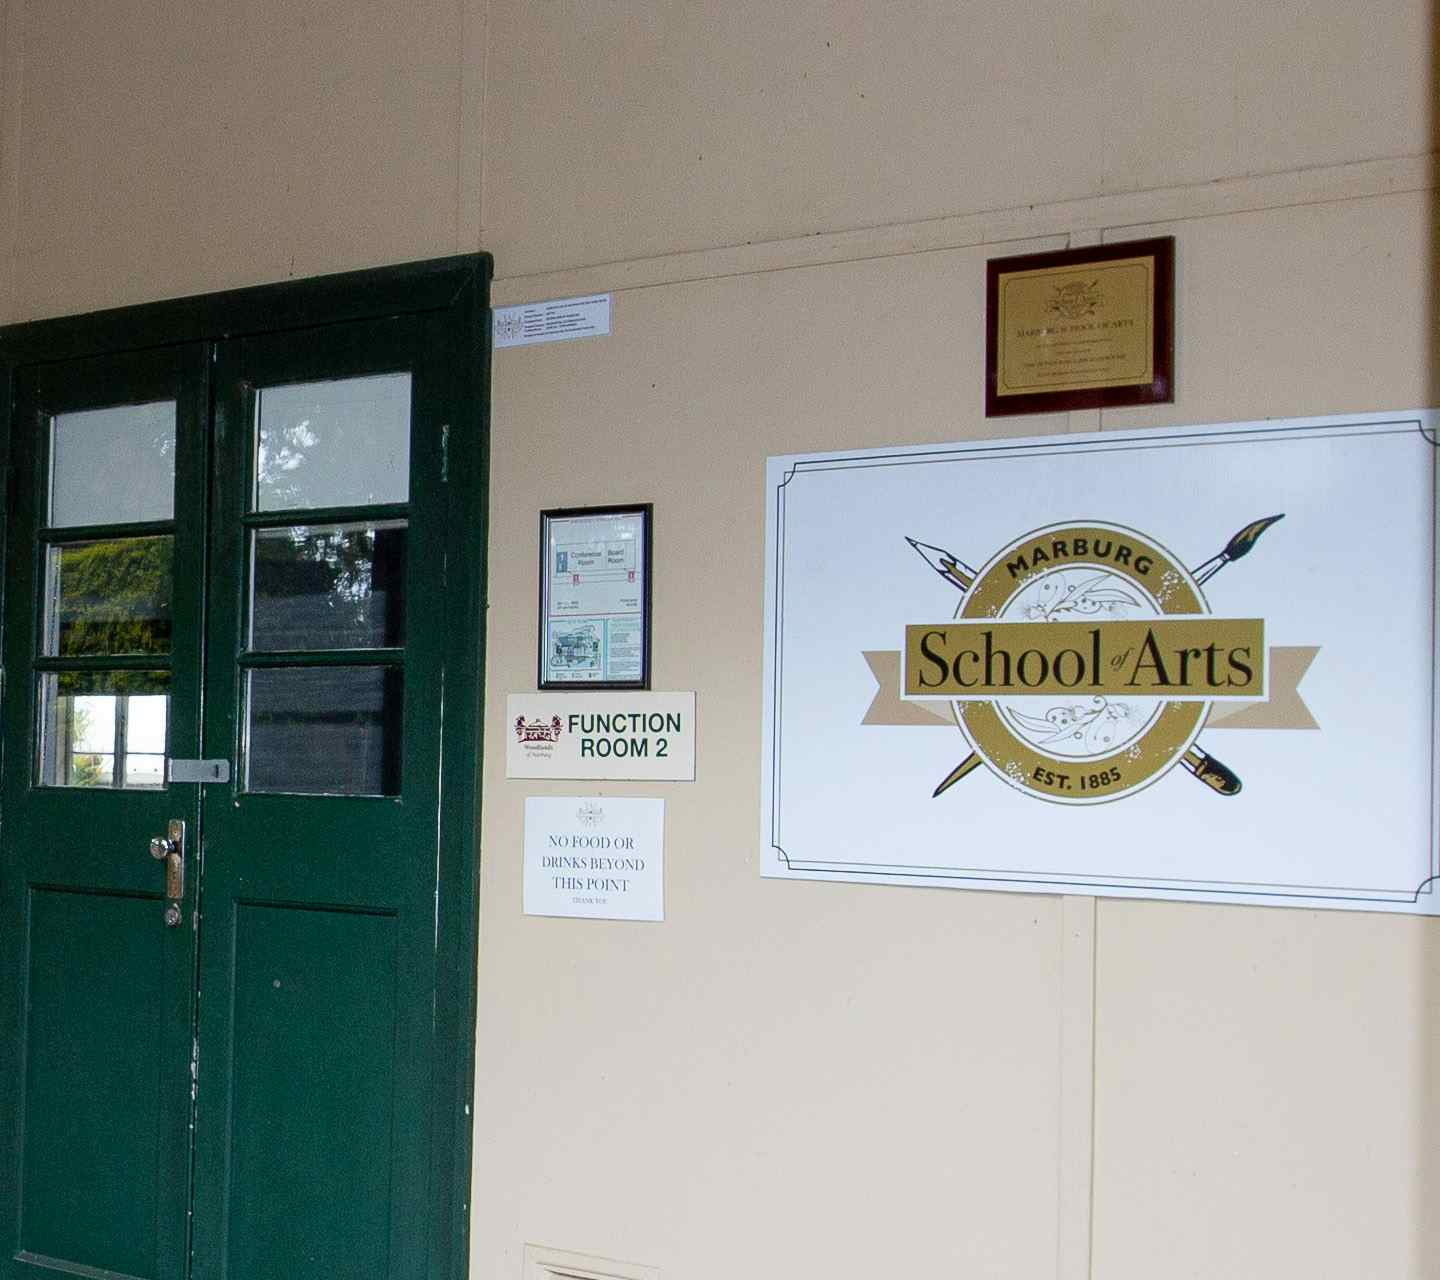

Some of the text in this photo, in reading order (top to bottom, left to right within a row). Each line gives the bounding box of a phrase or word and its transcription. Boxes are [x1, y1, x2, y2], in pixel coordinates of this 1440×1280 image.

[1007, 538, 1155, 579] MARBURG
[918, 627, 1254, 688] School of Arts
[568, 713, 682, 733] FUNCTION
[581, 738, 668, 757] ROOM 2
[1032, 766, 1122, 791] EST. 1885
[549, 835, 635, 850] NO FOOD OR
[542, 856, 645, 871] DRINKS BEYOND
[553, 877, 630, 892] THIS POINT
